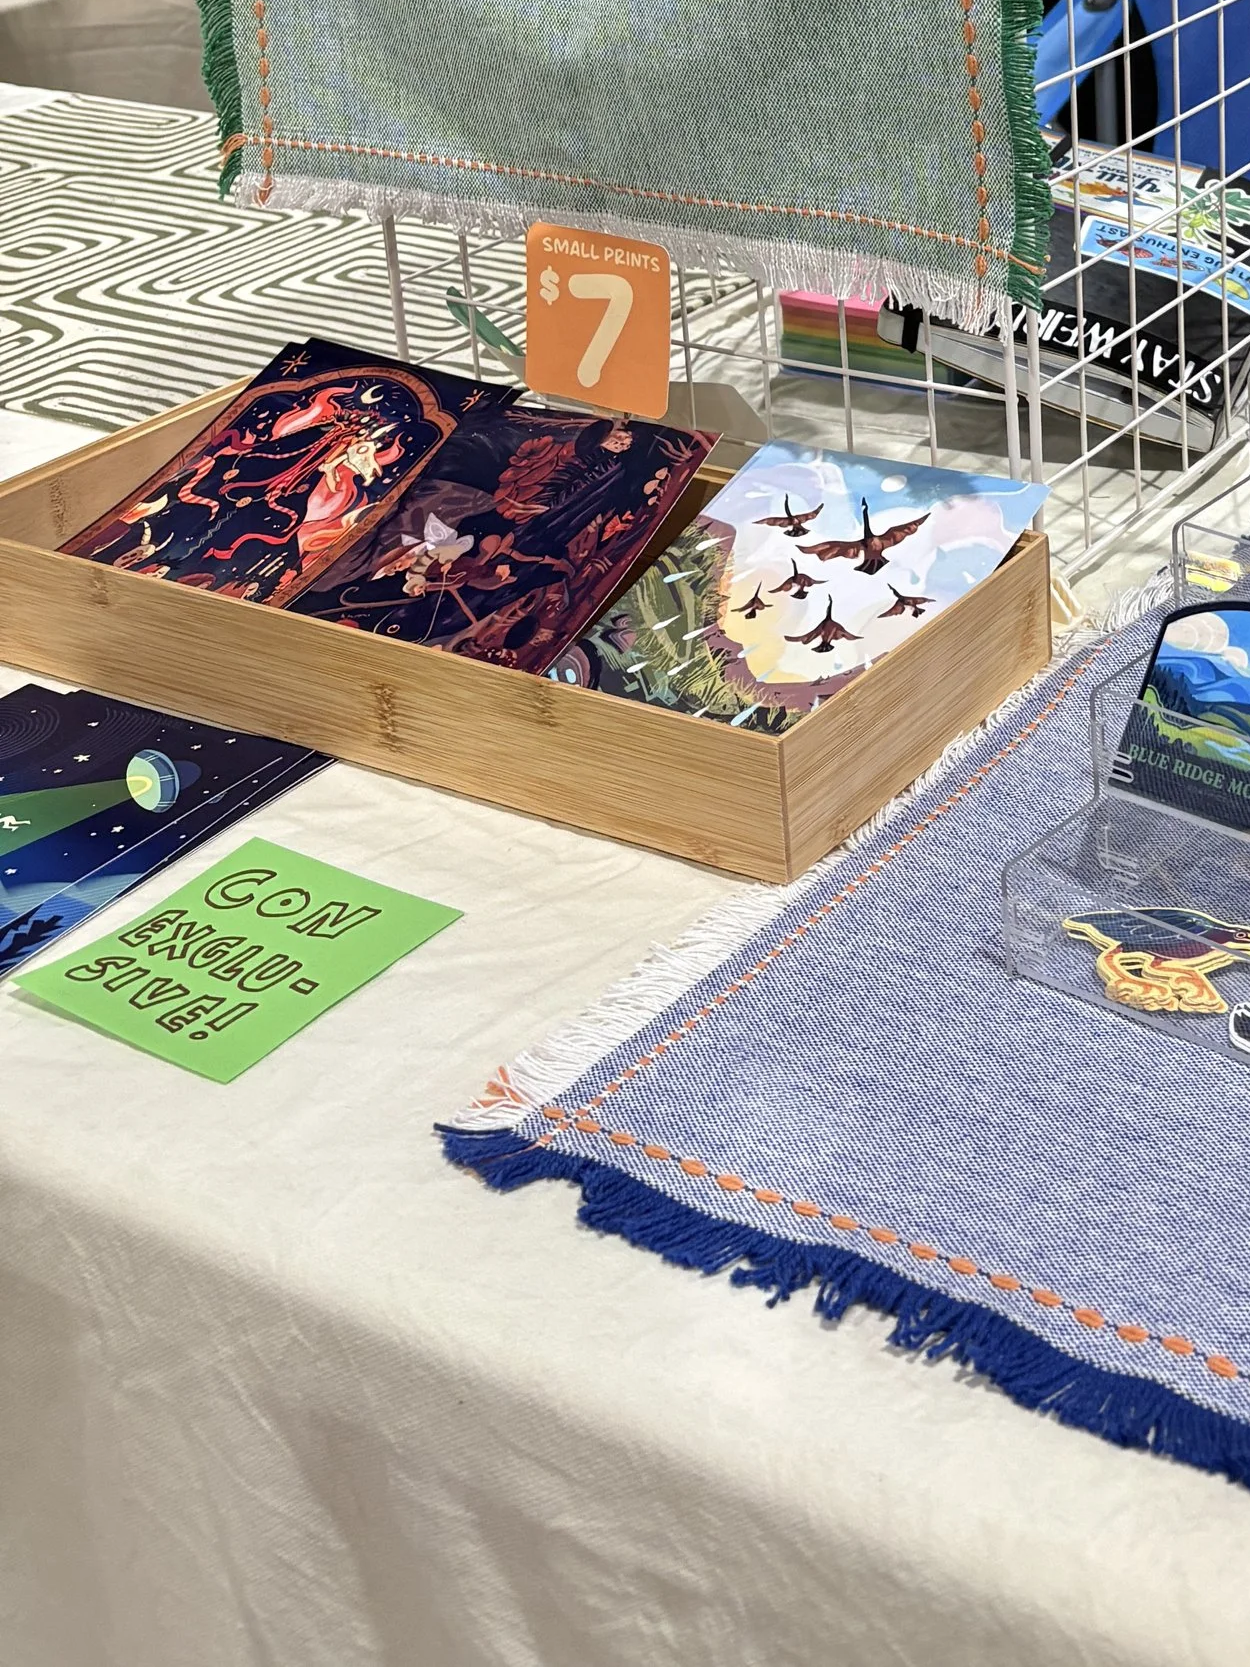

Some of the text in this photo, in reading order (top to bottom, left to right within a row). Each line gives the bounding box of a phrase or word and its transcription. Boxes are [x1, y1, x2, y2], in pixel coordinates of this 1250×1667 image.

[542, 236, 661, 273] SMALL PRINTS
[1128, 744, 1170, 770] BLUE
[1172, 758, 1225, 790] RIDGE
[204, 869, 382, 939] CON
[64, 956, 259, 1041] SIVE!
